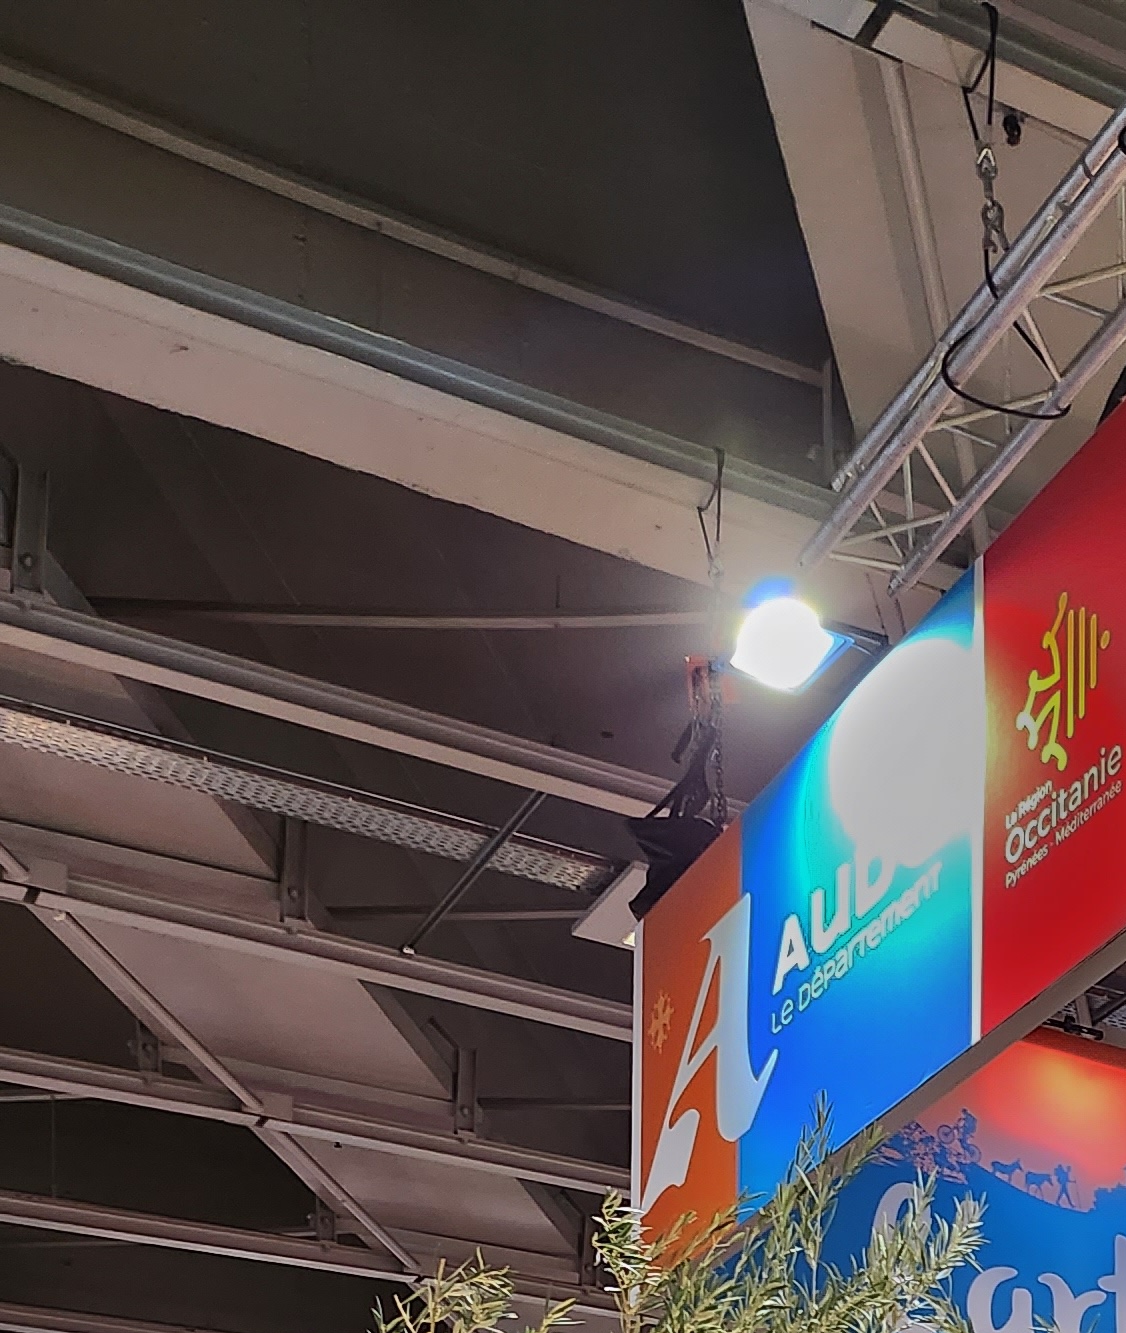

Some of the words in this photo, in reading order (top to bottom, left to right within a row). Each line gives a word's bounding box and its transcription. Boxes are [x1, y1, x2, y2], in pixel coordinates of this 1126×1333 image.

[1005, 745, 1122, 864] Occitanie
[1005, 843, 1049, 889] Pyrénées
[1055, 780, 1122, 846] Méditerranée
